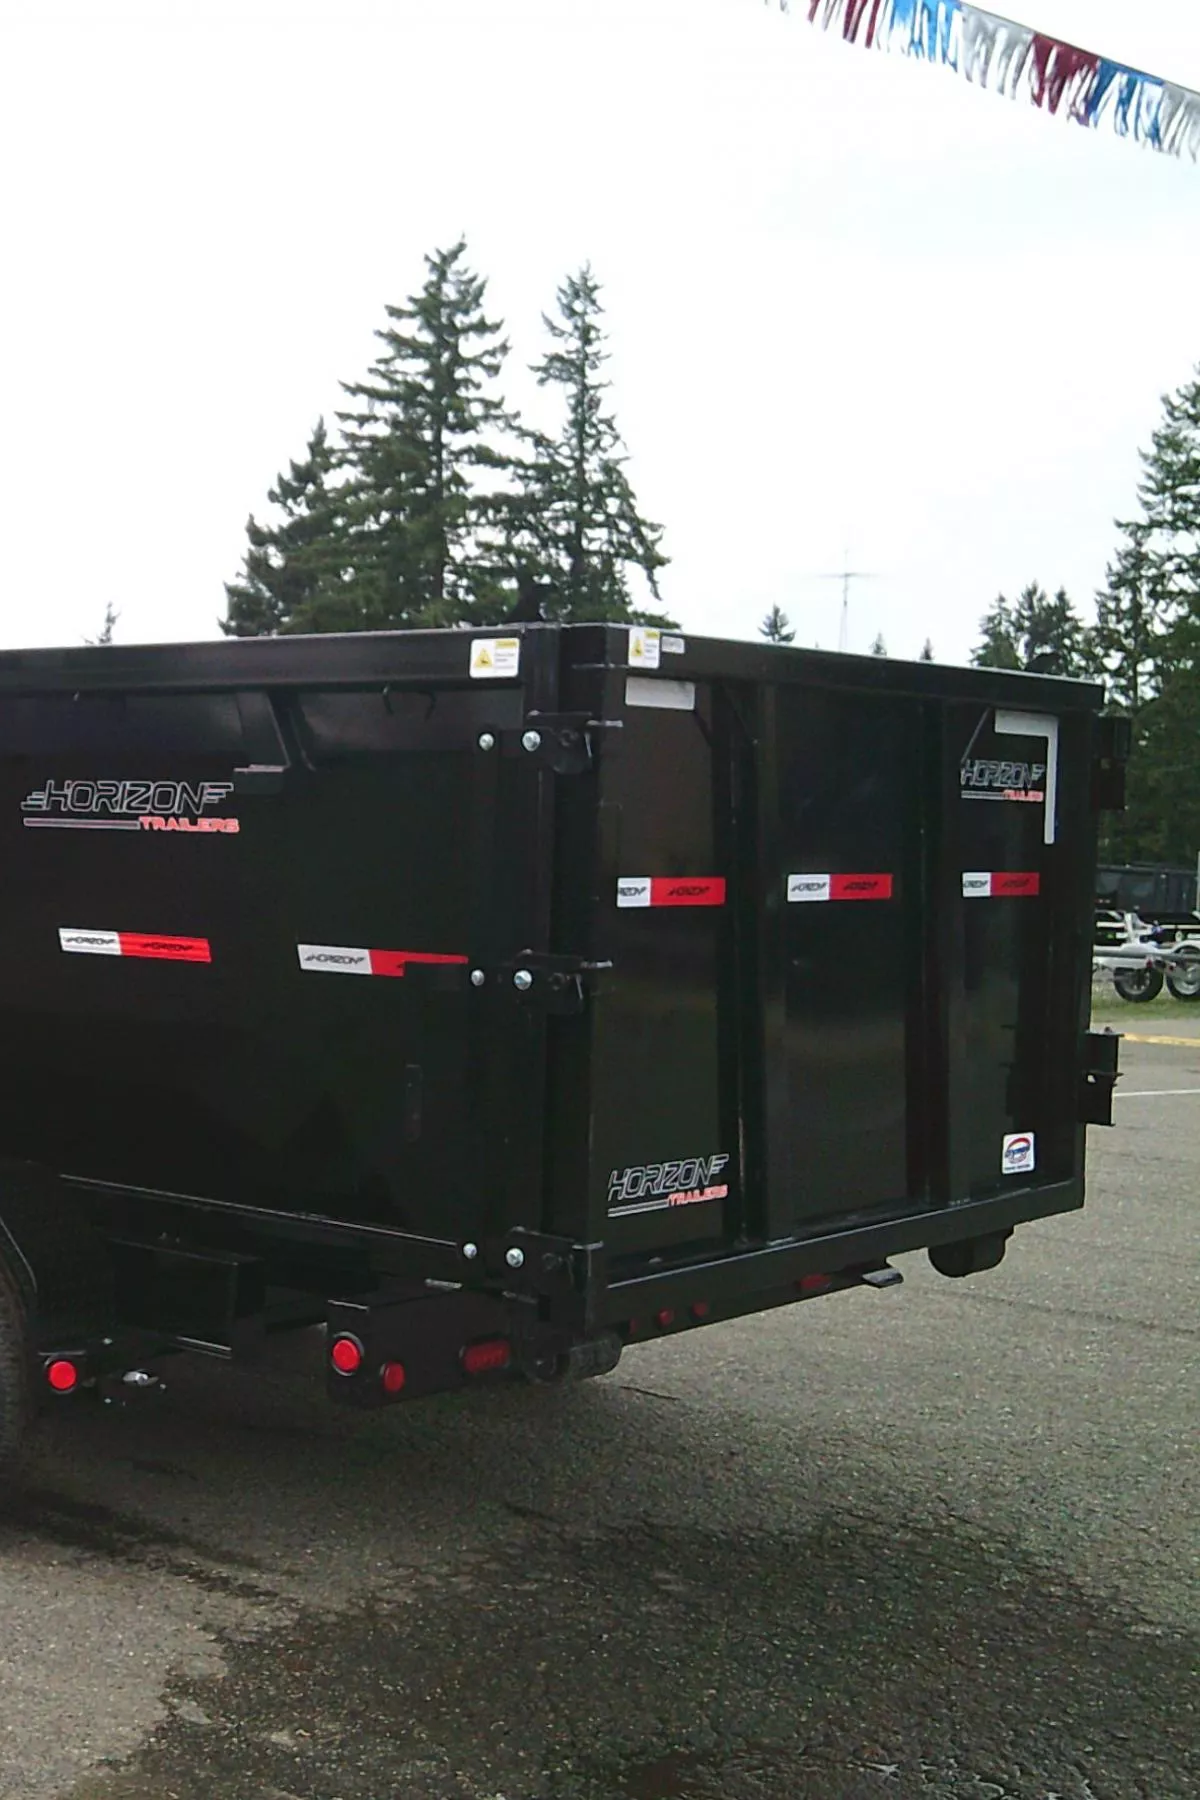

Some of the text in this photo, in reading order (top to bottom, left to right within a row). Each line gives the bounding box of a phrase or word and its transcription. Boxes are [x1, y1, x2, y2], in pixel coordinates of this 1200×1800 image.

[961, 759, 1036, 789] HORIZON
[43, 780, 210, 814] HORIZON
[139, 816, 240, 832] TRAILERS
[304, 953, 365, 965] HORIZON
[608, 1156, 716, 1201] HORIZON
